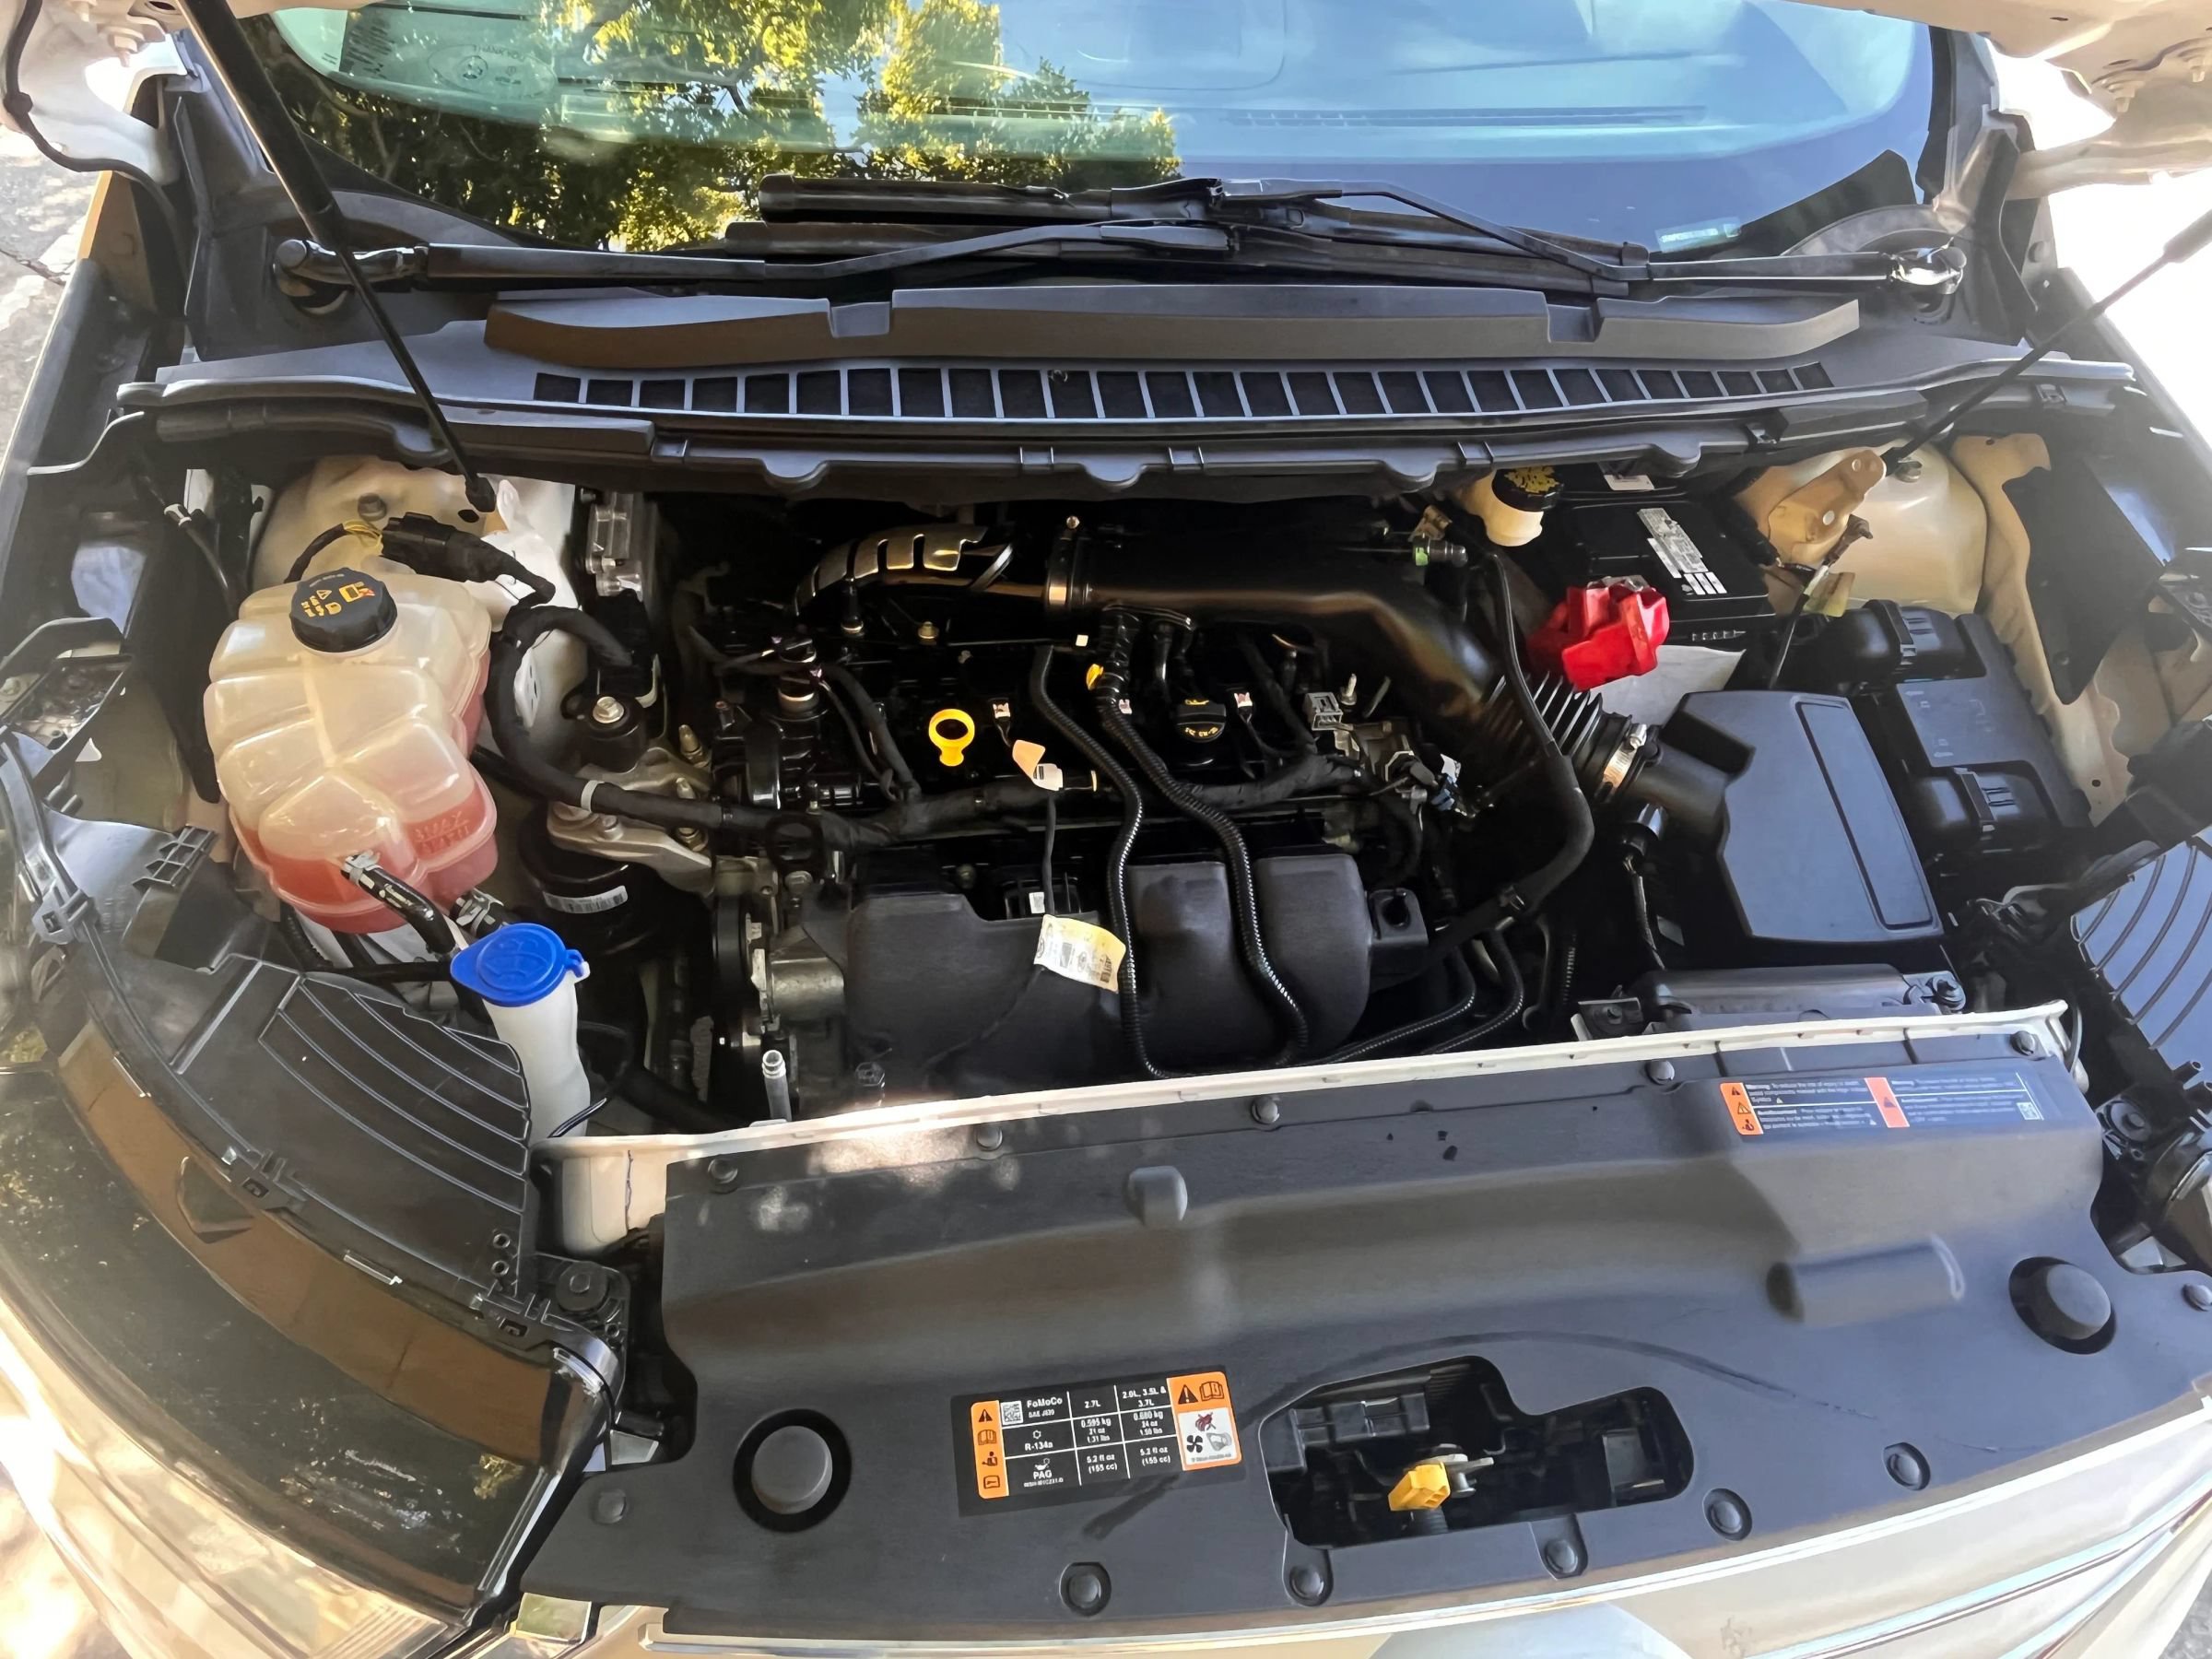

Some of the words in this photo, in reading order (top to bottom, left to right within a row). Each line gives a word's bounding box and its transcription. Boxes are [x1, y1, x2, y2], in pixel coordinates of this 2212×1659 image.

[1027, 1397, 1063, 1408] FoMoCo
[1085, 1400, 1100, 1408] 2.7L
[1138, 1399, 1155, 1407] 3.7L
[1024, 1441, 1053, 1452] R-134a
[1086, 1454, 1098, 1464] 5.2
[1032, 1469, 1053, 1480] PAG
